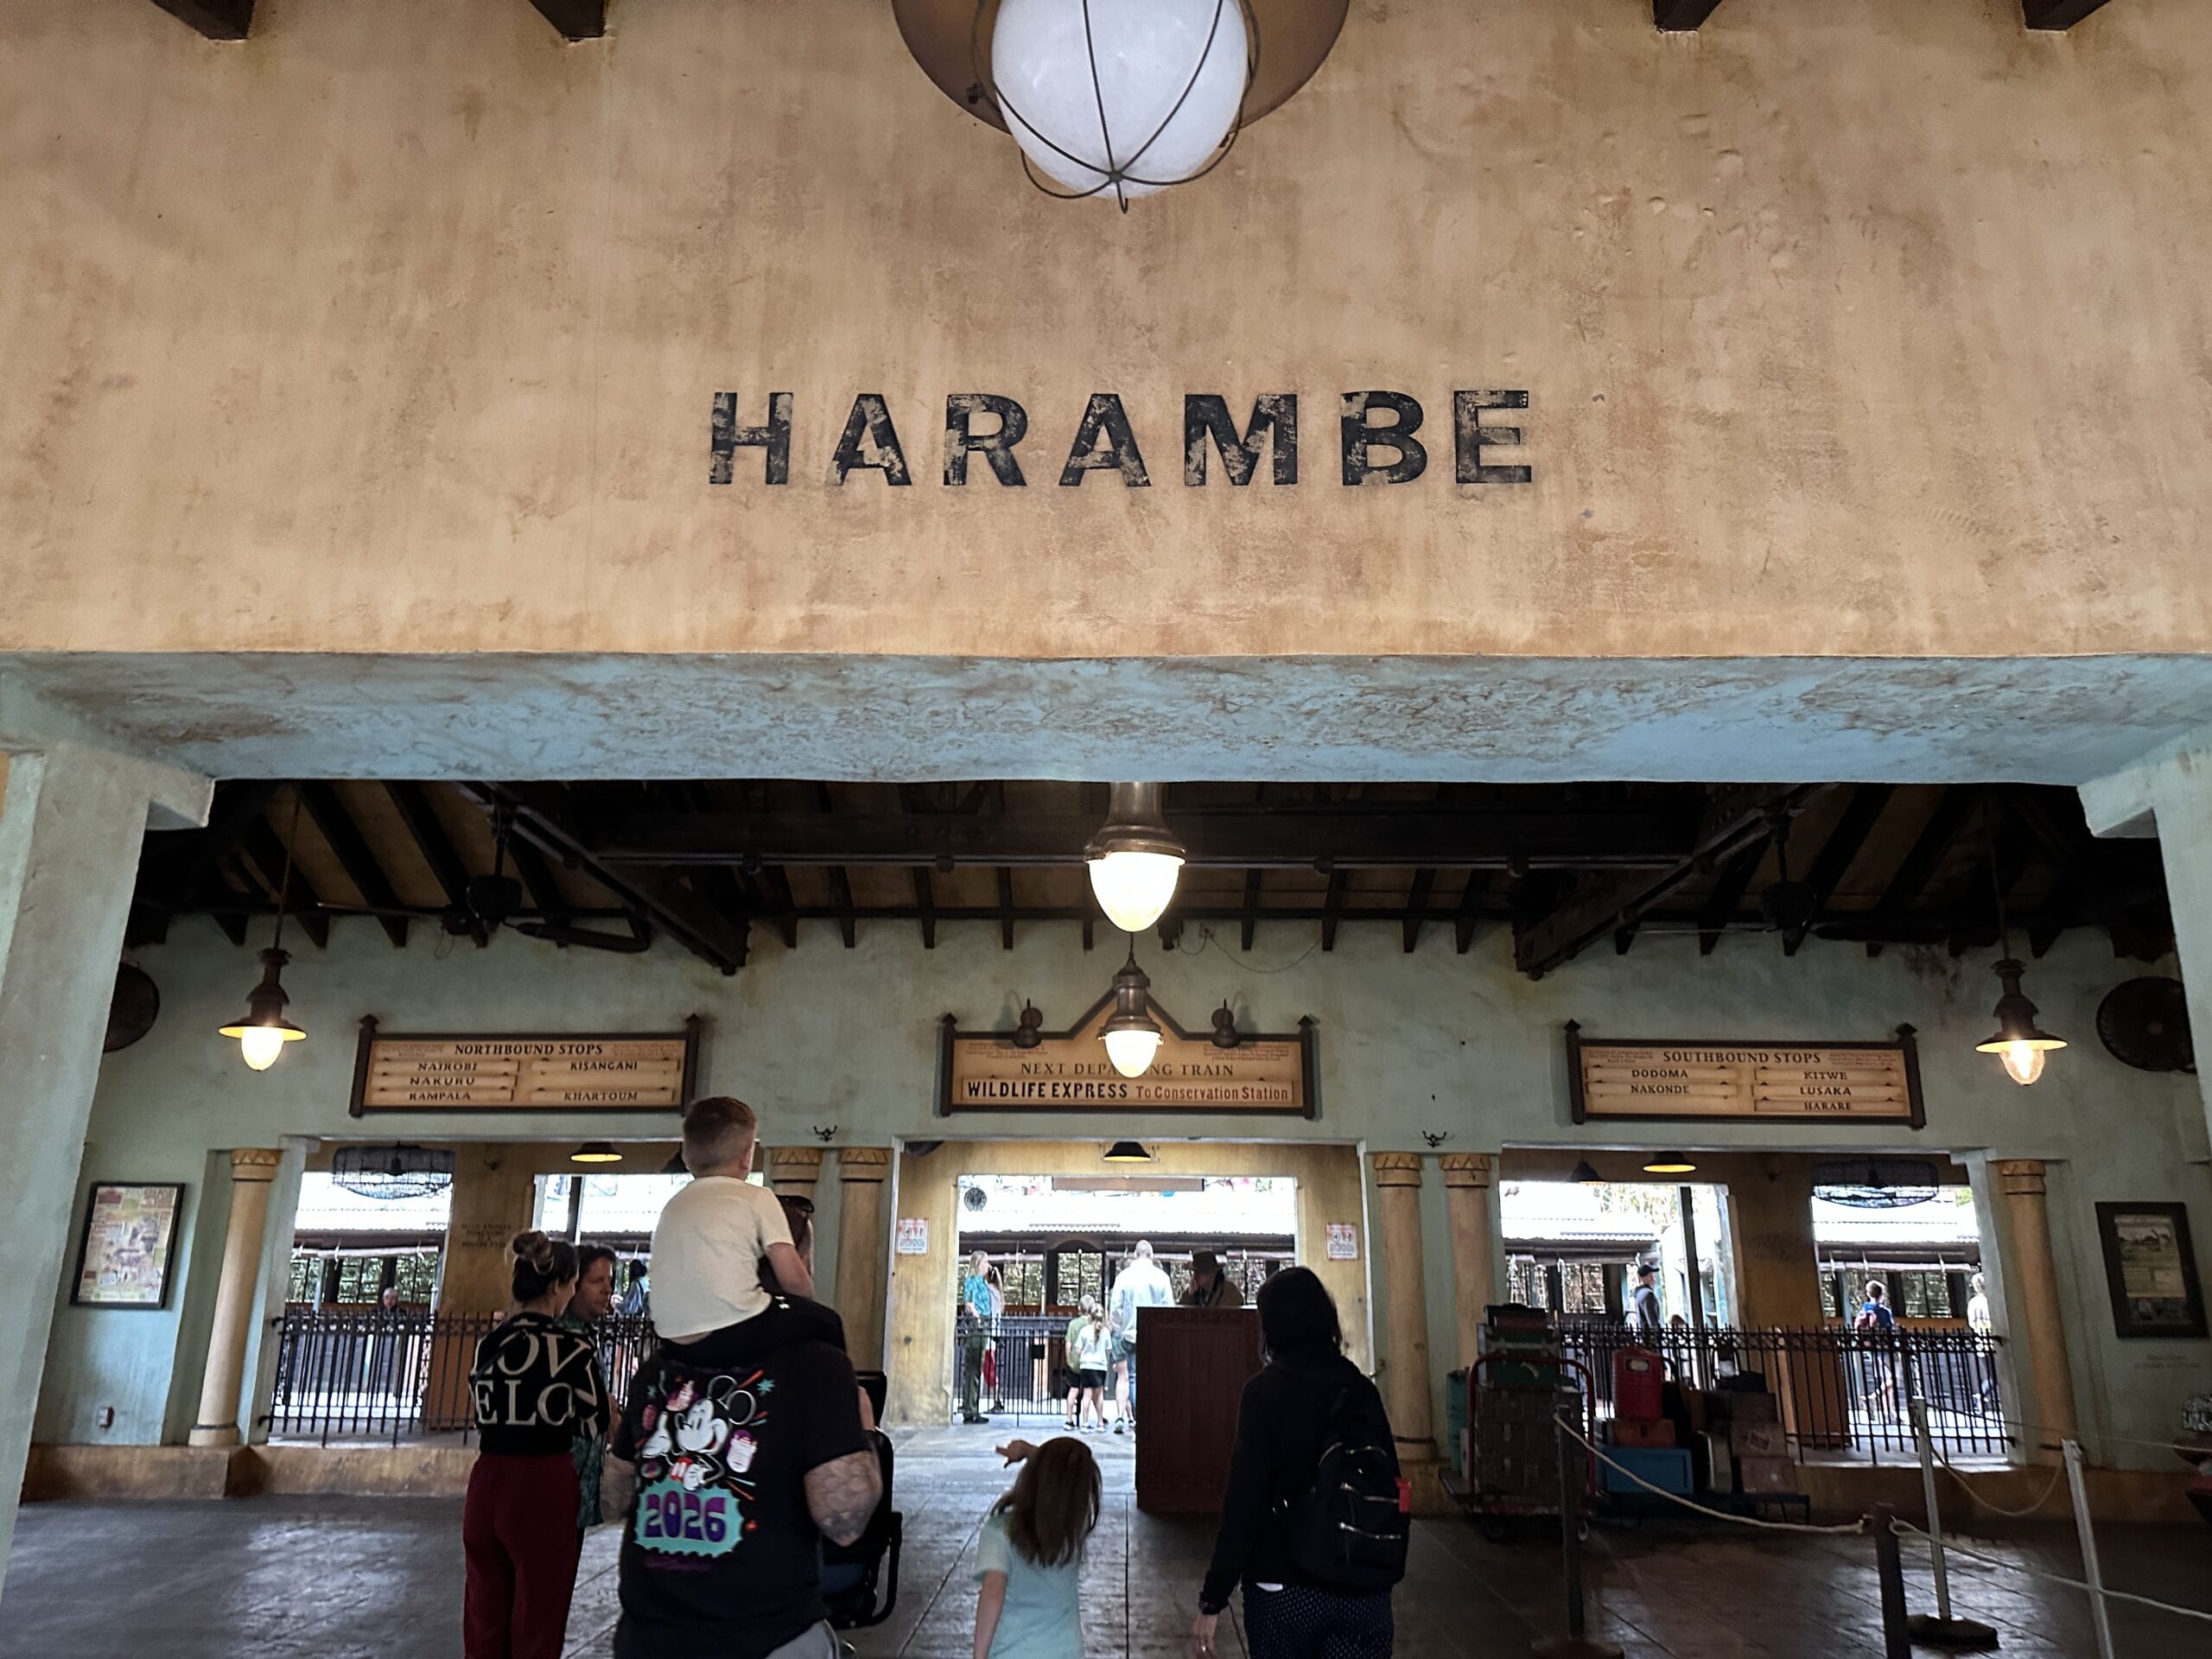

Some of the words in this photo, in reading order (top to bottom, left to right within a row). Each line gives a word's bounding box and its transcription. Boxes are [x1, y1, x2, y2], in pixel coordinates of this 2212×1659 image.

[708, 391, 1532, 486] HARAMBE
[454, 1043, 554, 1055] NORTHBOUND
[558, 1043, 603, 1055] STOPS
[1662, 1051, 1770, 1063] SOUTHBOUND
[1774, 1052, 1821, 1064] STOPS
[417, 1062, 478, 1071] NAIROBI
[569, 1061, 639, 1071] KISANGANI
[1021, 1063, 1065, 1075] NEXT
[1074, 1063, 1173, 1077] DEPANG
[1180, 1064, 1234, 1077] TRAIN
[1631, 1069, 1689, 1079] DODOMA
[1803, 1071, 1849, 1081] KITWE
[410, 1077, 475, 1086] NAKURU
[967, 1081, 1046, 1099] WILDLIFE
[1052, 1082, 1128, 1099] EXPRESS
[1135, 1085, 1151, 1099] To
[1154, 1085, 1239, 1101] Conservation
[1242, 1086, 1288, 1101] Station
[1630, 1084, 1690, 1095] NAKONDE
[1800, 1086, 1853, 1096] LUSAKA
[409, 1091, 471, 1101] KAMPALA
[563, 1091, 639, 1102] KHARTOUM
[1803, 1101, 1853, 1111] HARARE
[644, 1490, 727, 1543] 2026
